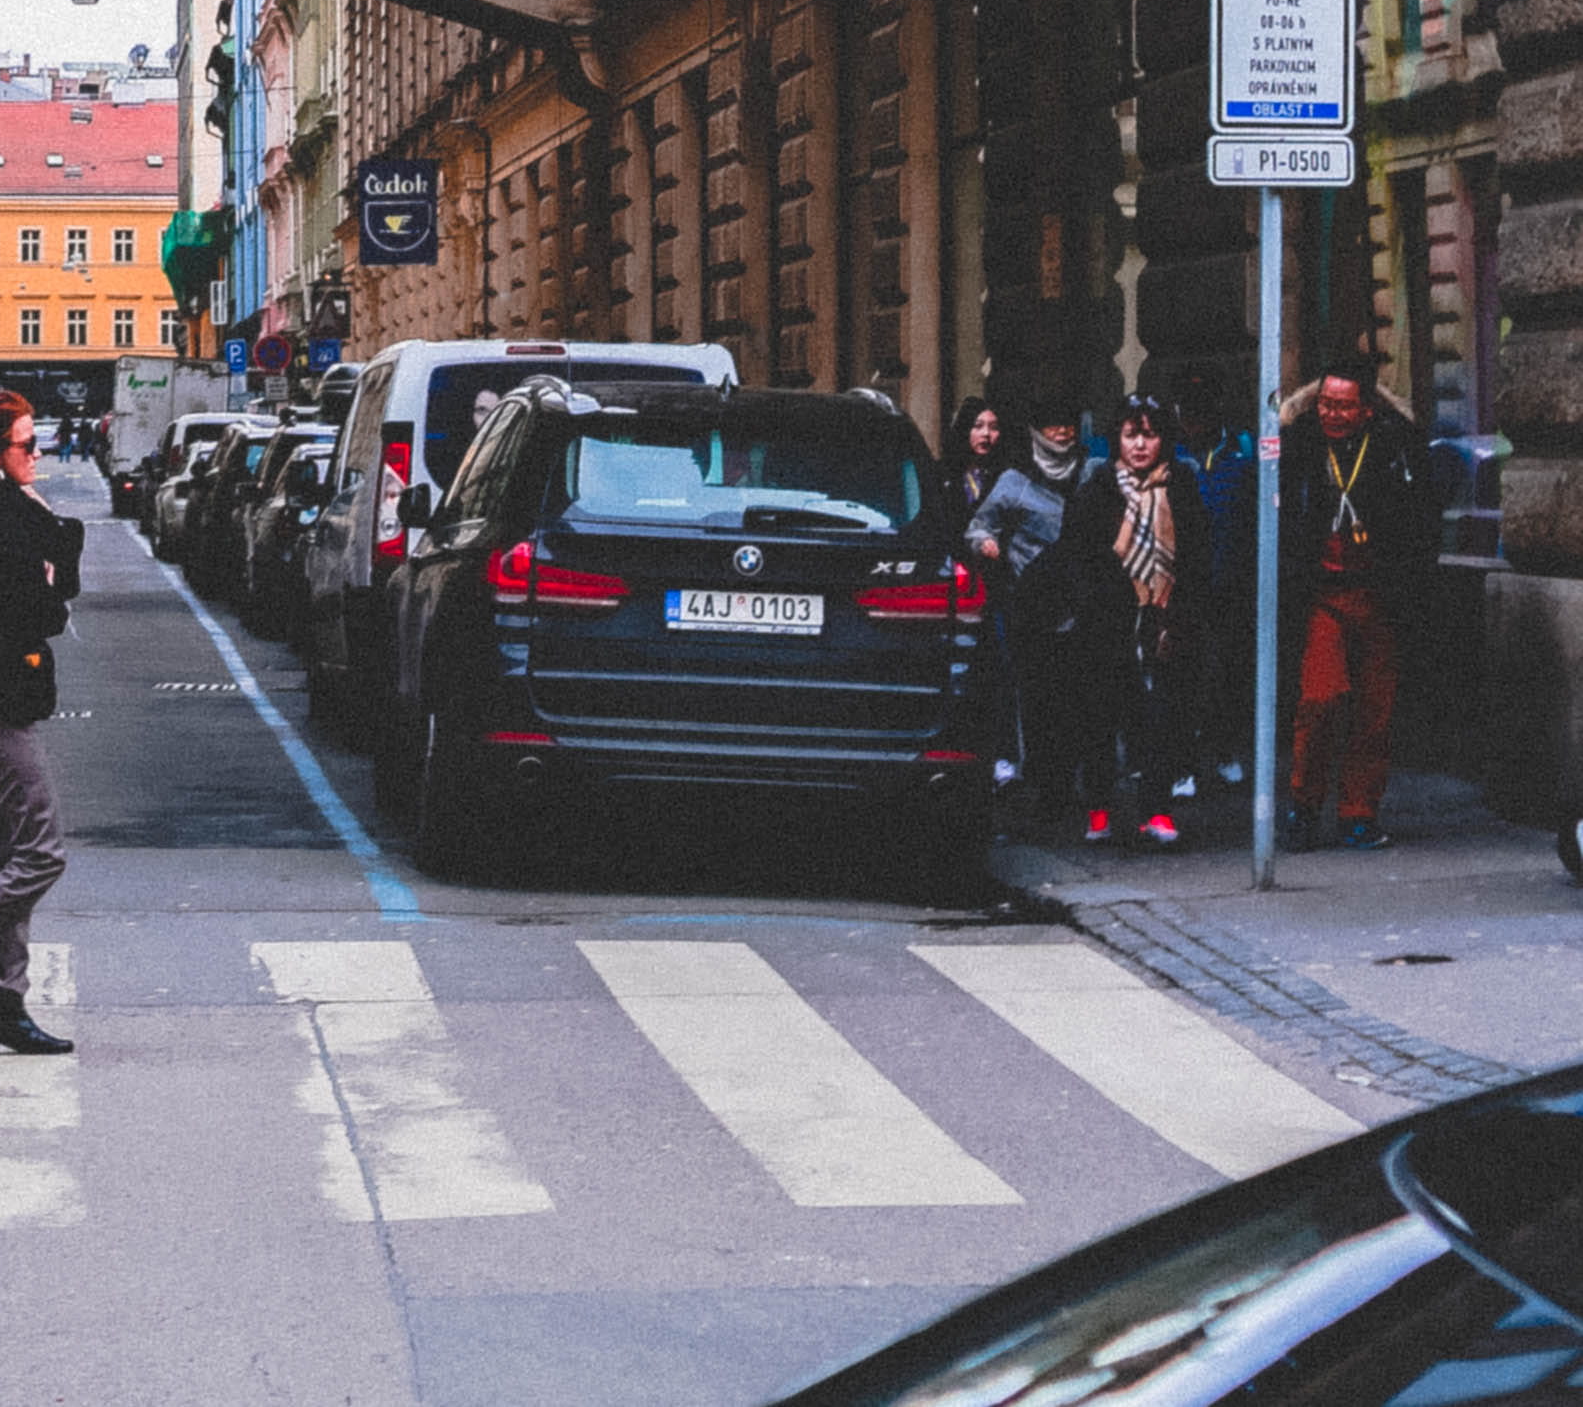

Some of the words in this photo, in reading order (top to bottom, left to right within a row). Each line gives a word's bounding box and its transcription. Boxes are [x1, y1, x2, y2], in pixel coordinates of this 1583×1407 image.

[1252, 36, 1260, 51] S
[1252, 102, 1303, 116] OBLAST
[1307, 103, 1314, 116] 1
[1259, 149, 1330, 172] P1-0500
[871, 561, 916, 575] X5
[687, 593, 732, 618] 4AJ
[751, 596, 811, 621] 0103
